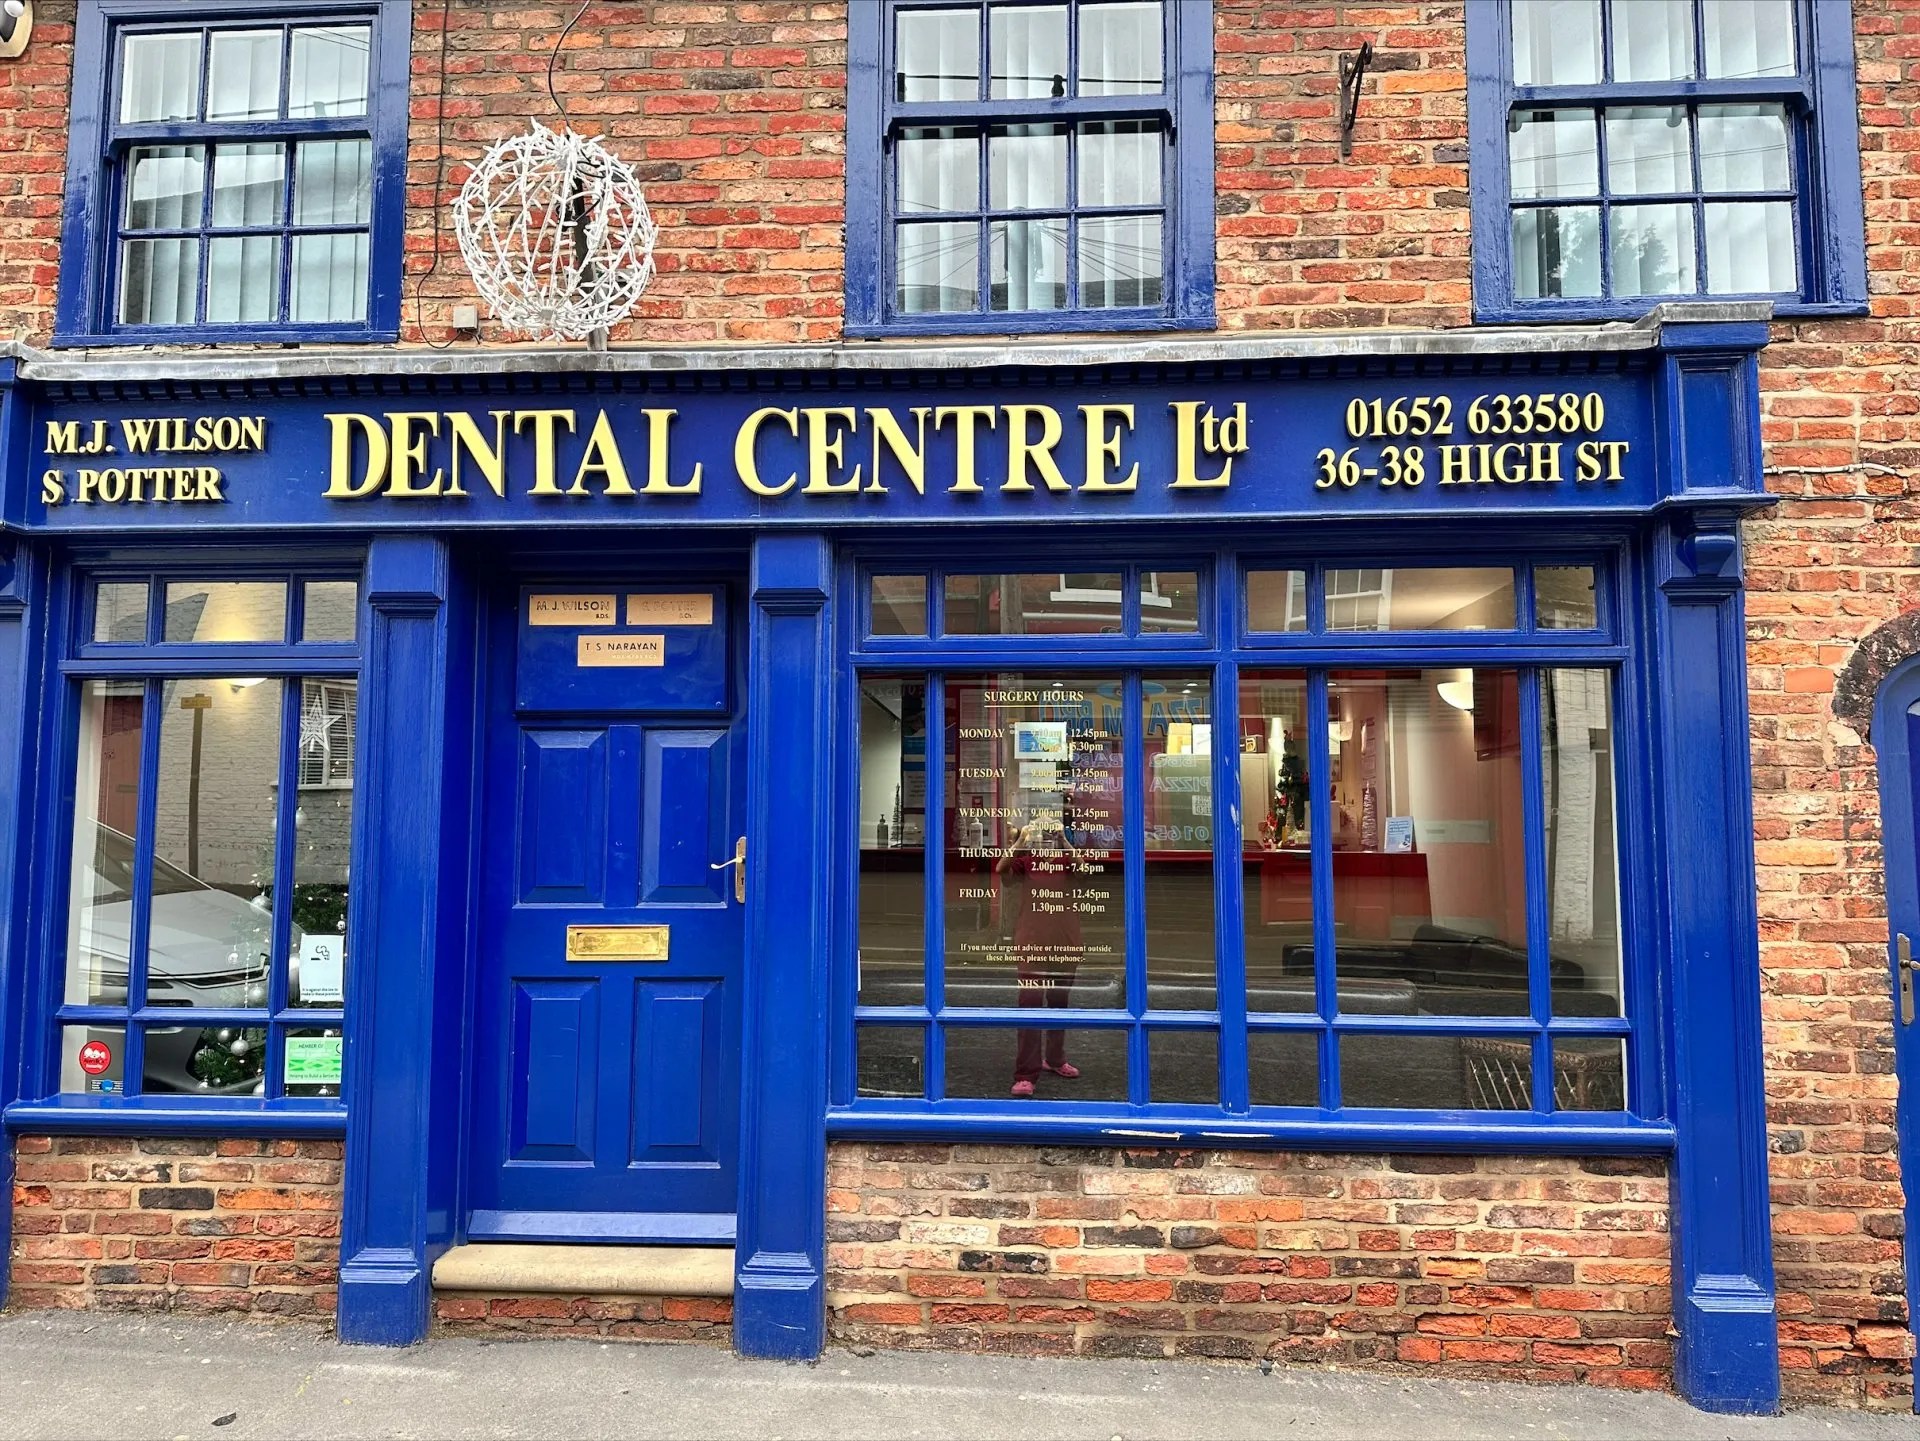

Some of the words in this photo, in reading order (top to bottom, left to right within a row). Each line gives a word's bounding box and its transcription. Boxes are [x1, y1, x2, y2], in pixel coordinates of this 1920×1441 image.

[1345, 395, 1454, 438] 01652
[1466, 392, 1605, 436] 633580
[44, 420, 115, 454] M.J.
[120, 416, 266, 453] WILSON
[321, 408, 703, 498] DENTAL
[734, 404, 1140, 497] CENTRE
[1167, 400, 1250, 490] Ltd
[1314, 445, 1425, 490] 36-38
[1437, 442, 1564, 485] HIGH
[1575, 441, 1630, 483] ST
[42, 469, 65, 504] S
[75, 466, 226, 503] POTTER
[562, 601, 610, 611] WILSON
[984, 691, 1040, 701] SURGERY
[1043, 690, 1084, 701] HOURS
[959, 728, 1005, 738] MONDAY
[1071, 728, 1108, 740] 12.45pm
[1072, 742, 1104, 753] 5.30pm
[959, 768, 1007, 778] TUESDAY
[1071, 768, 1108, 780] 12.45pm
[1071, 782, 1104, 793] 7.45pm
[959, 808, 1025, 818] WEDNESDAY
[1031, 808, 1062, 818] 9.00am
[1072, 808, 1109, 819] 12.45pm
[1071, 822, 1104, 832] 5.30pm
[959, 848, 1016, 858] THURSDAY
[1031, 848, 1063, 858] 9.00am
[1072, 848, 1109, 860] 12.45pm
[1031, 862, 1064, 873] 2.00pm
[1071, 863, 1104, 874] 7.45pm
[959, 889, 998, 898] FRIDAY
[1031, 889, 1064, 899] 9.00am
[1072, 889, 1110, 900] 12.45pm
[1031, 903, 1064, 914] 1.30pm
[1072, 903, 1105, 914] 5.00pm
[960, 943, 968, 951] If
[968, 945, 980, 953] you
[982, 943, 997, 951] need
[999, 944, 1021, 953] urgent
[1022, 943, 1043, 951] advice
[1087, 945, 1112, 953] outside
[1027, 954, 1048, 963] please
[1017, 979, 1039, 989] NHS
